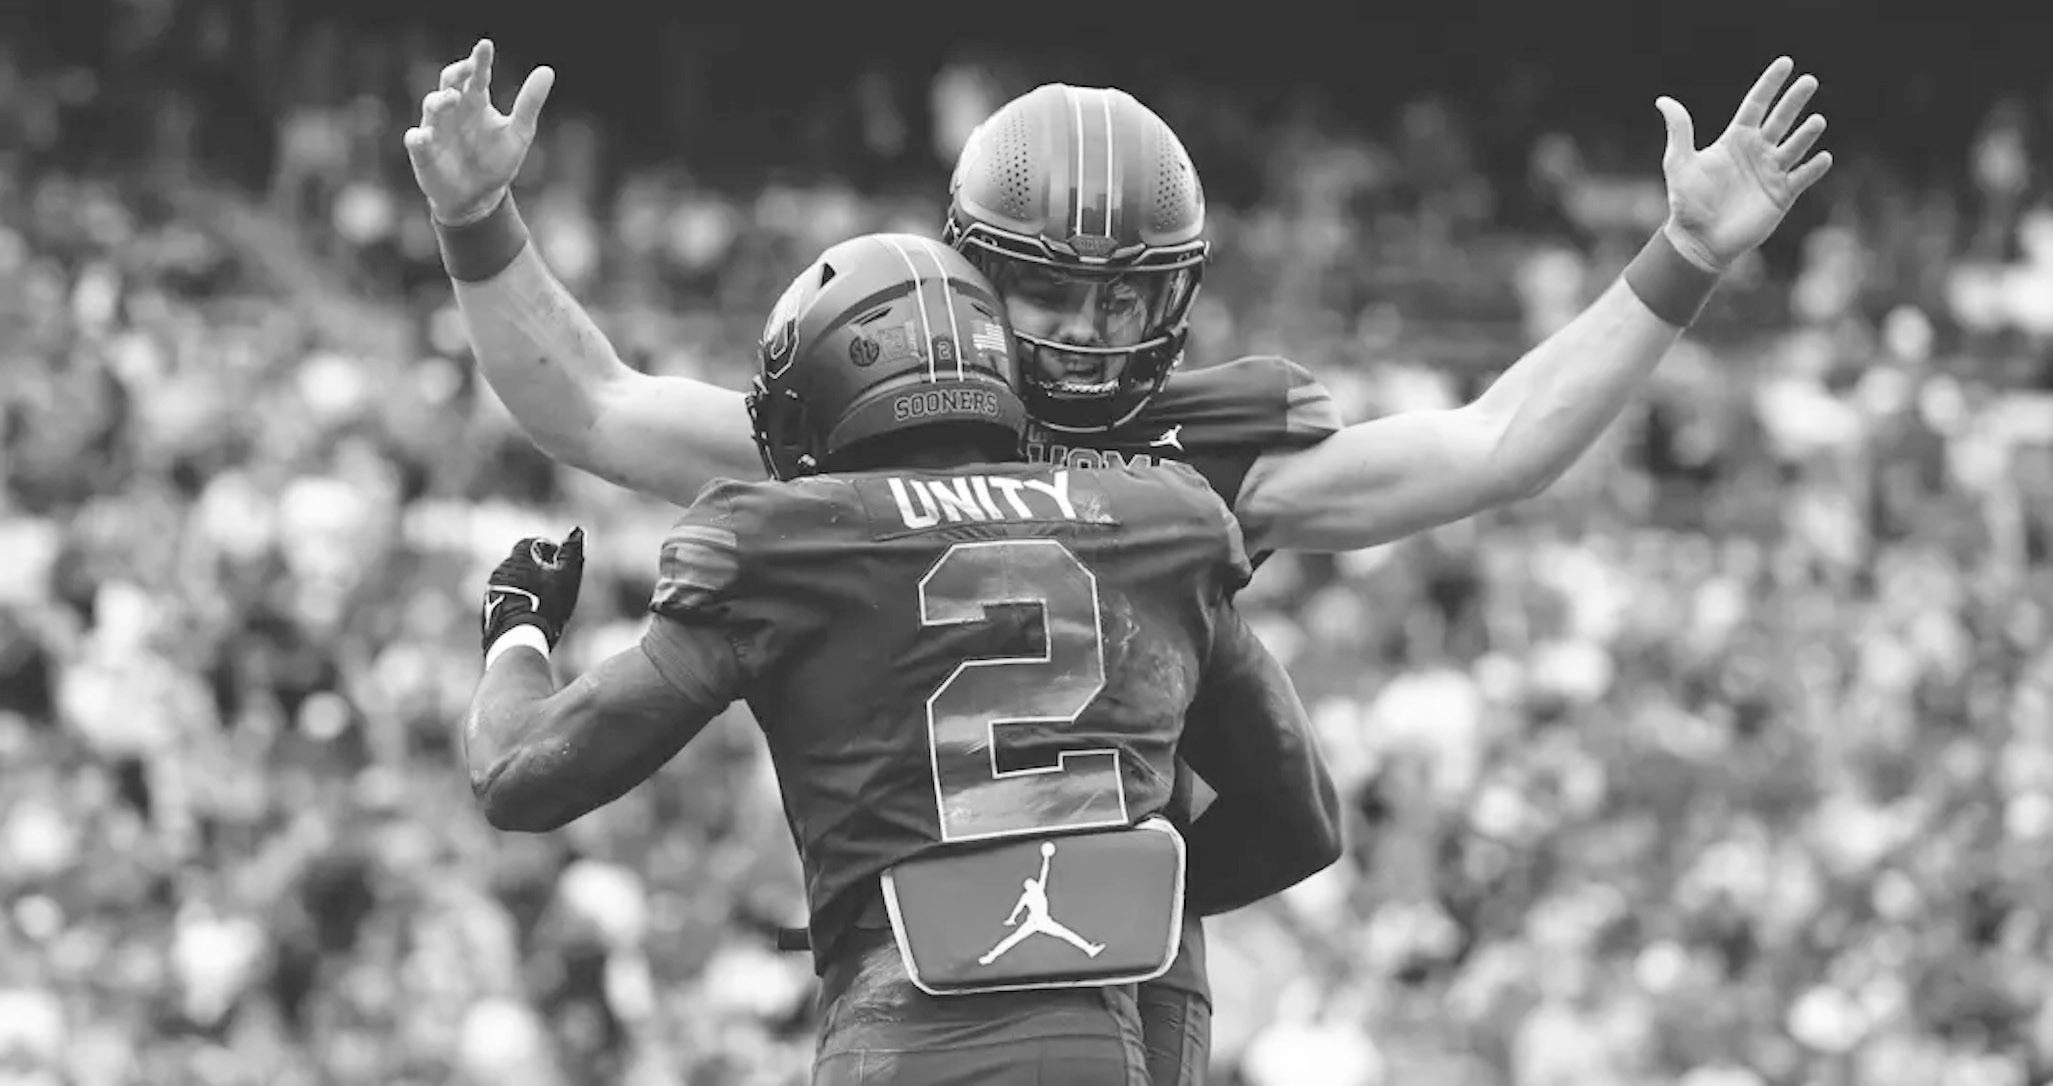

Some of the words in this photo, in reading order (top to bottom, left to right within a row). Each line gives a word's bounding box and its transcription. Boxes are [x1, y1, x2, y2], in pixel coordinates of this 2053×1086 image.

[936, 341, 951, 360] 2
[894, 388, 999, 421] SOONERS
[888, 470, 1076, 529] UNITY
[918, 539, 1129, 843] 2
